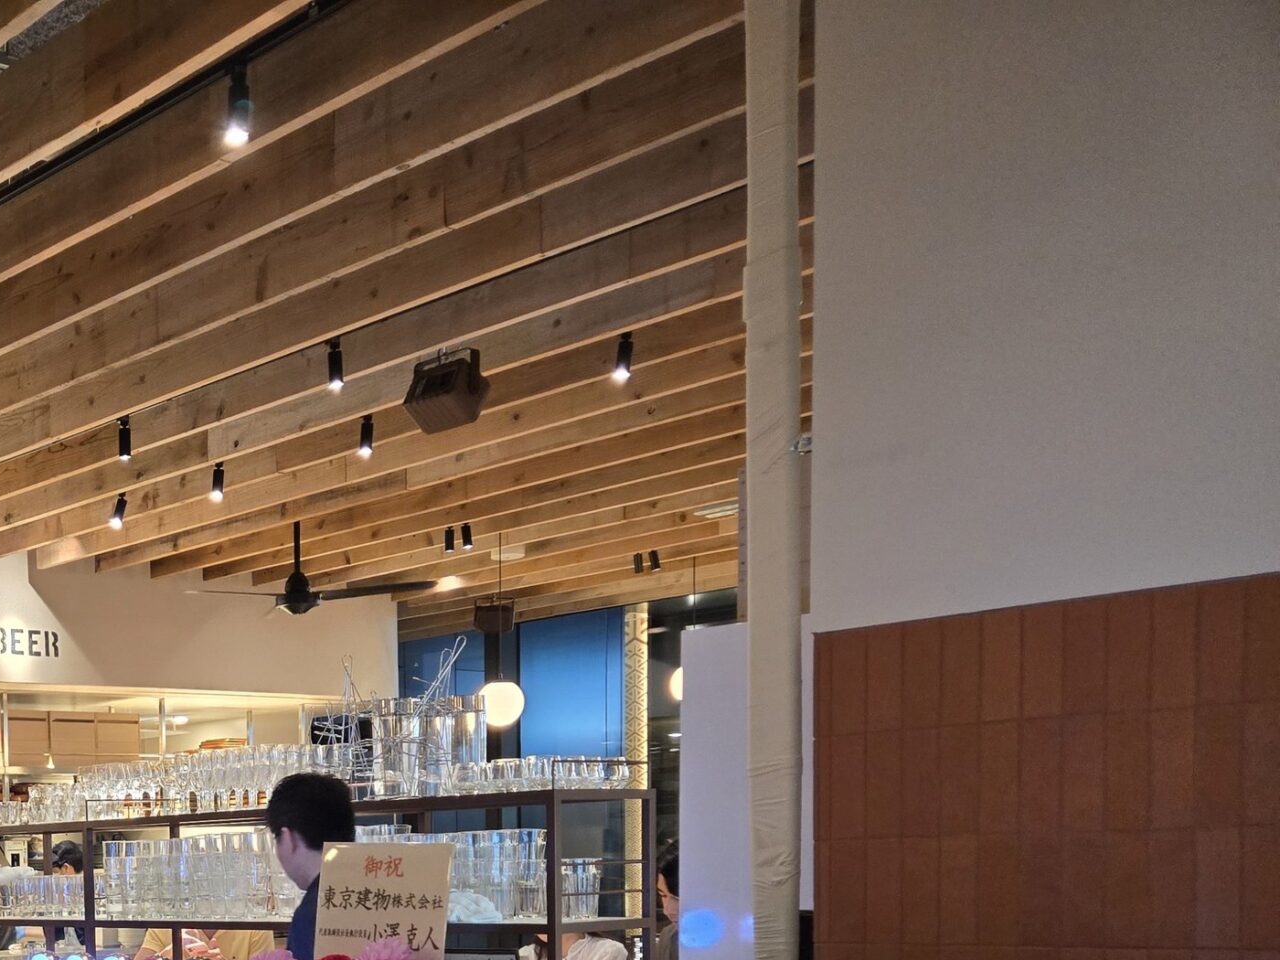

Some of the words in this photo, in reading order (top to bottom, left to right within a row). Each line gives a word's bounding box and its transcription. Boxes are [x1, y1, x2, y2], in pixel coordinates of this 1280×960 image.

[364, 855, 404, 878] 御祝
[320, 885, 444, 911] 東京建物株式会社
